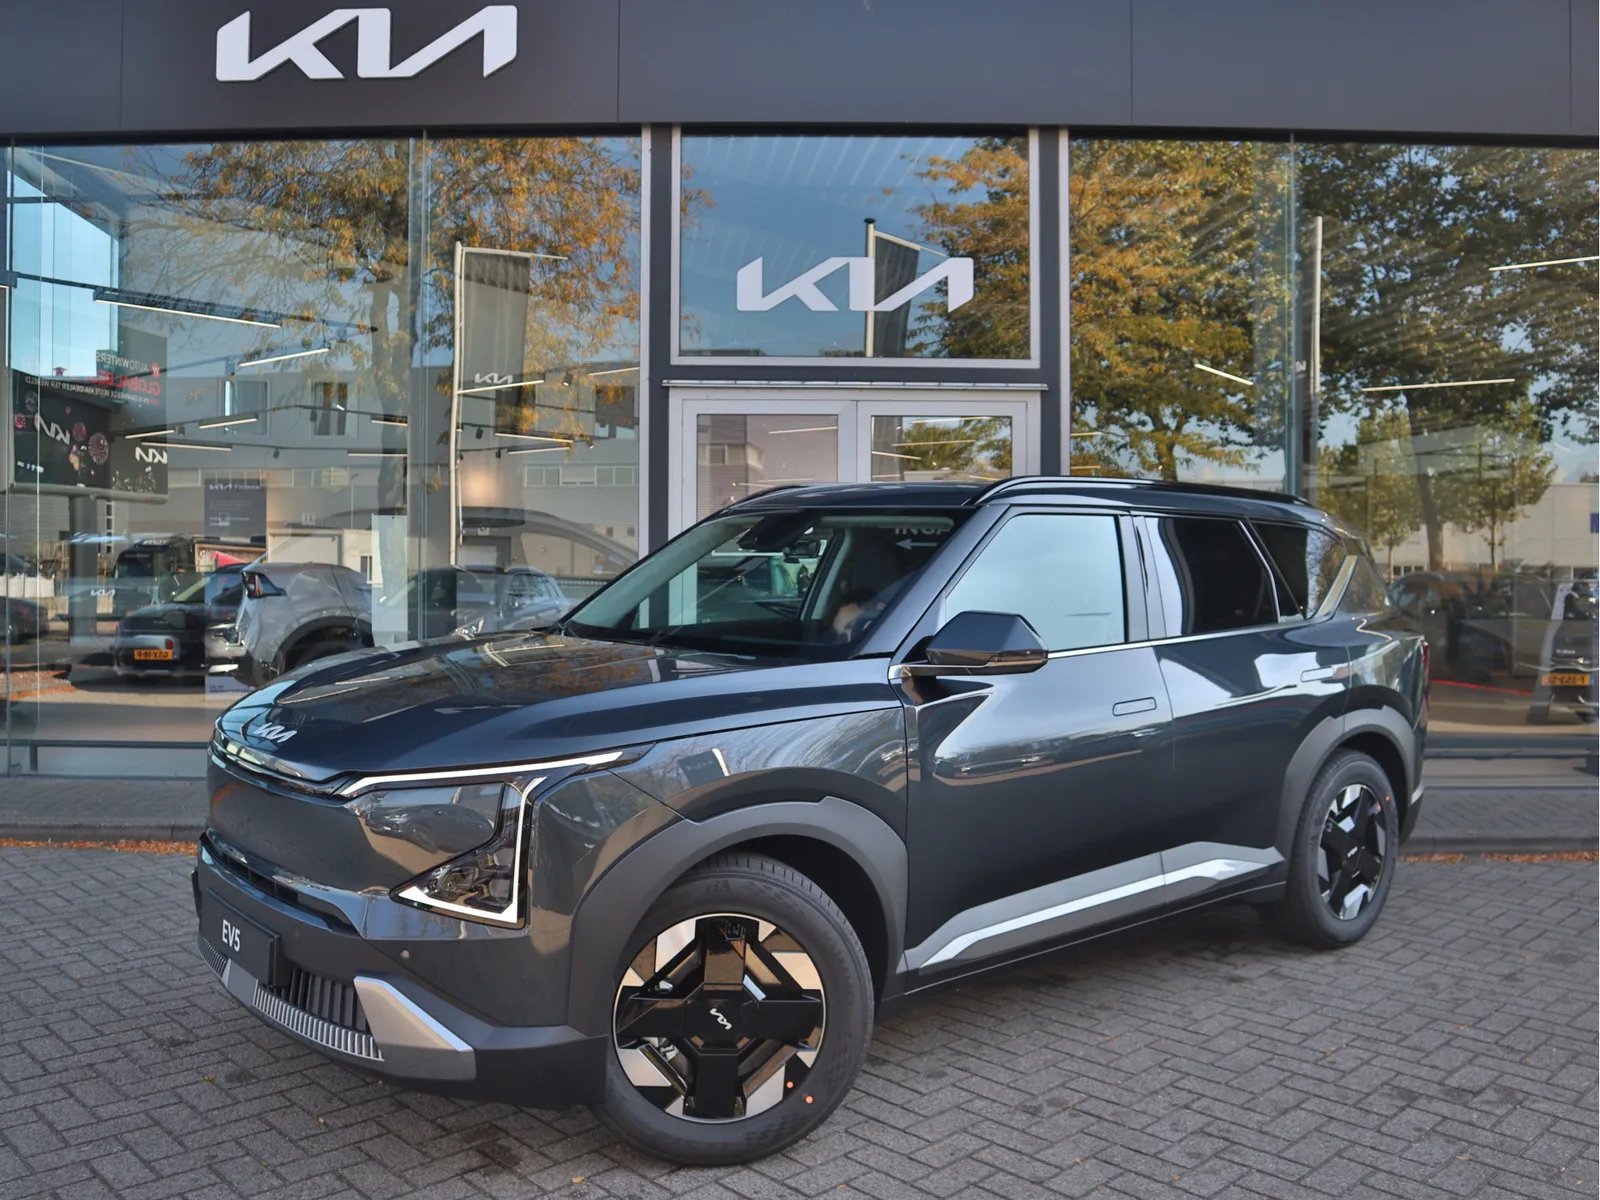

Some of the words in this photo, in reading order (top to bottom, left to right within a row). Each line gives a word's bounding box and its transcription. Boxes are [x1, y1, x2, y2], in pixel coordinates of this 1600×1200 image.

[216, 4, 518, 81] KIA
[736, 256, 975, 313] KIA
[474, 372, 513, 384] KIA
[90, 588, 115, 597] KIA
[253, 721, 298, 743] KIA
[222, 919, 242, 952] EV5
